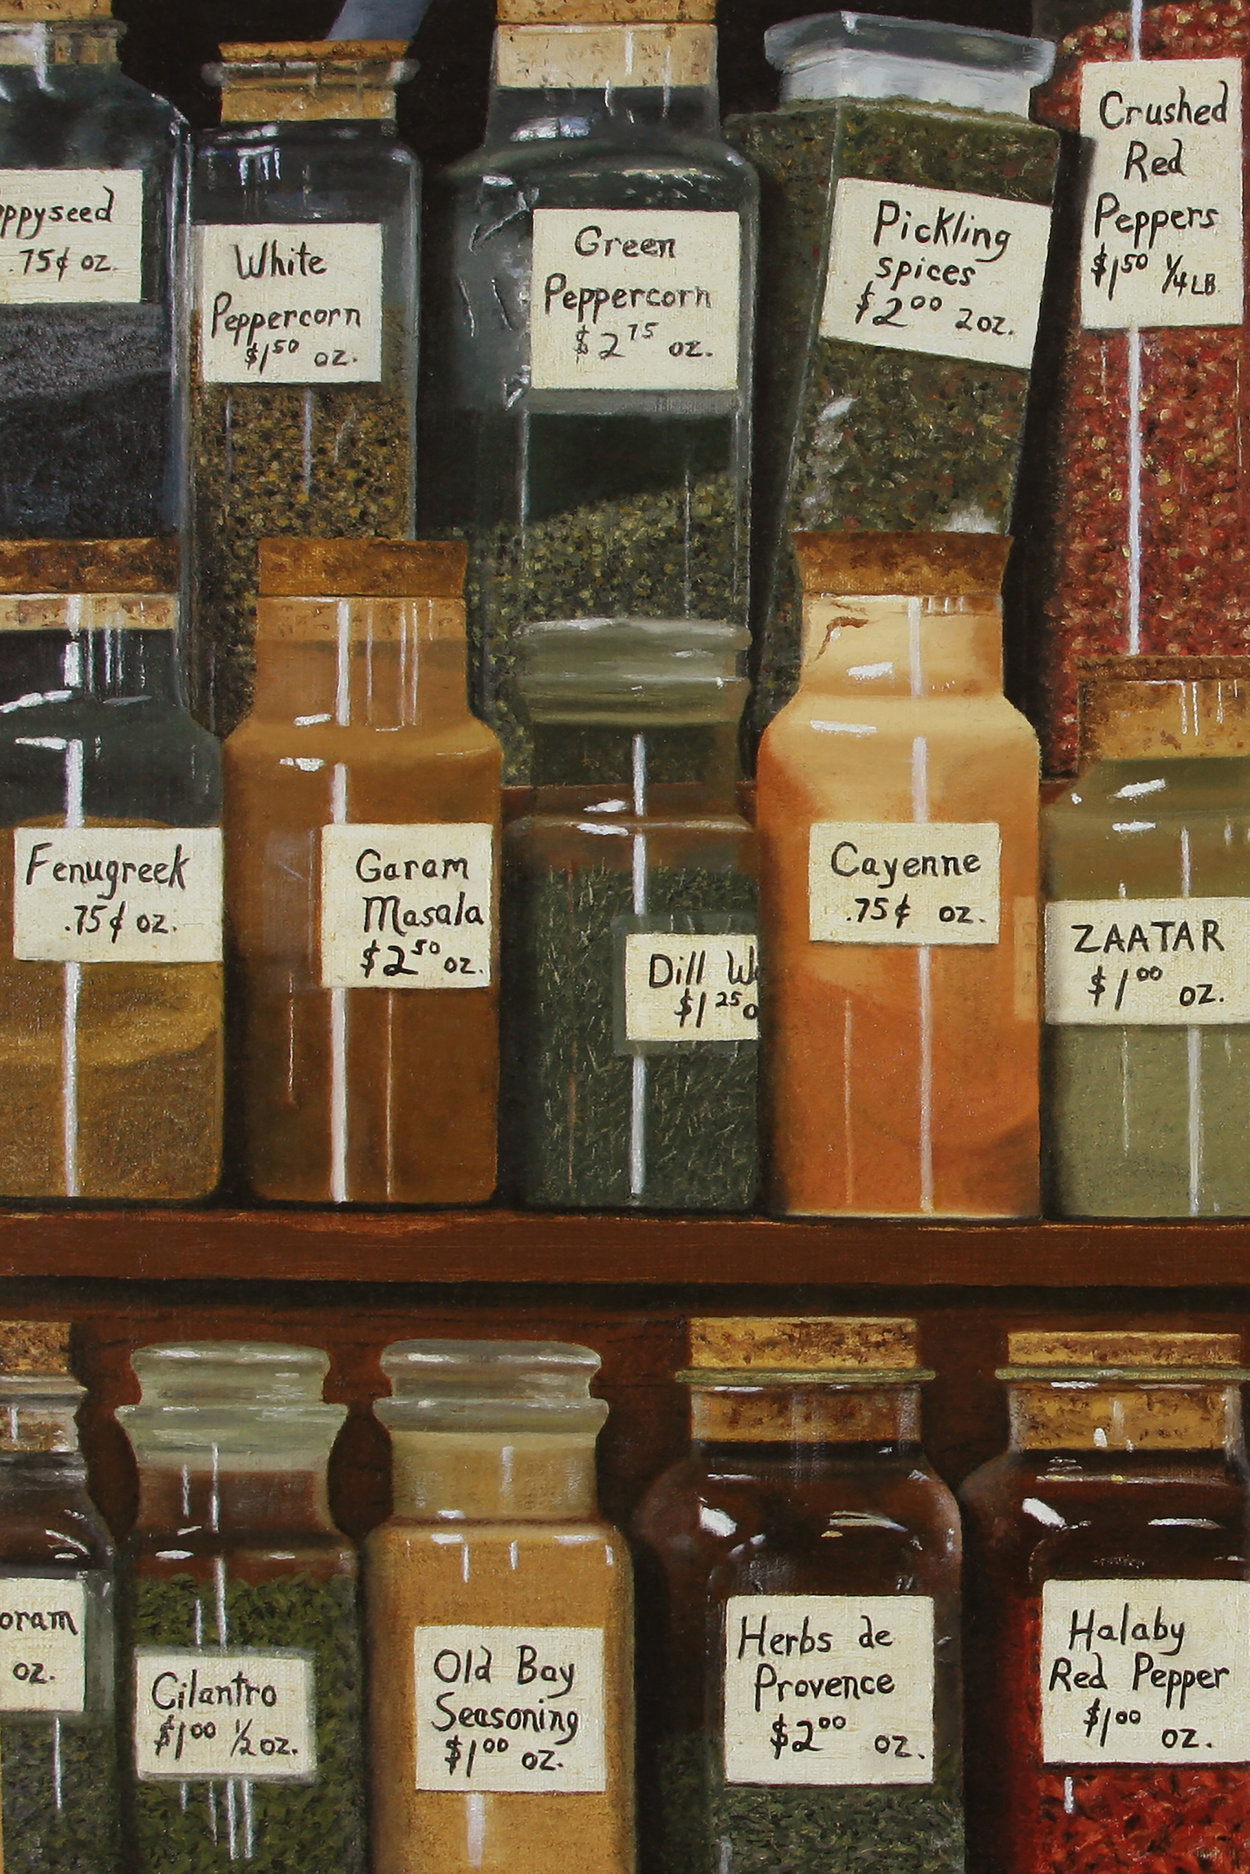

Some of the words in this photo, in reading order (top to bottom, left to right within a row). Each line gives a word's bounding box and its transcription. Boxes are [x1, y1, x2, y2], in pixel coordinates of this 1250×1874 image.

[1099, 80, 1229, 131] Crushed
[1123, 137, 1187, 184] Red
[1094, 191, 1220, 250] Peppers
[233, 239, 327, 281] White
[574, 225, 676, 259] Green
[9, 246, 70, 282] .75¢
[80, 252, 118, 272] oz.
[544, 272, 711, 325] Peppercorn
[211, 290, 361, 355] Peppercorn
[313, 349, 358, 368] oz.
[668, 341, 713, 358] oz.
[25, 842, 190, 901] Fenugreek
[355, 848, 469, 883] Garam
[830, 840, 981, 890] Cayenne
[64, 900, 126, 944] .75¢
[136, 913, 178, 935] oz.
[362, 891, 485, 938] Masala
[846, 893, 911, 930] .75¢
[938, 905, 986, 924] oz.
[1070, 919, 1225, 954] ZAATAR
[442, 953, 485, 976] oz.
[648, 950, 706, 989] Dill
[1178, 983, 1225, 1007] oz.
[0, 1610, 79, 1636] oram
[737, 1614, 834, 1661] Herbs
[858, 1614, 894, 1650] de
[1068, 1602, 1185, 1657] Halaby
[12, 1662, 56, 1685] oz.
[151, 1668, 278, 1711] Cilantro
[433, 1645, 492, 1684] Old
[516, 1644, 575, 1700] Bay
[754, 1662, 896, 1713] Provence
[1048, 1651, 1109, 1692] Red
[1132, 1651, 1230, 1711] Pepper
[430, 1691, 579, 1754] Seasoning
[1161, 1728, 1213, 1749] oz.
[521, 1749, 564, 1772] oz.
[874, 1734, 926, 1760] oz.
